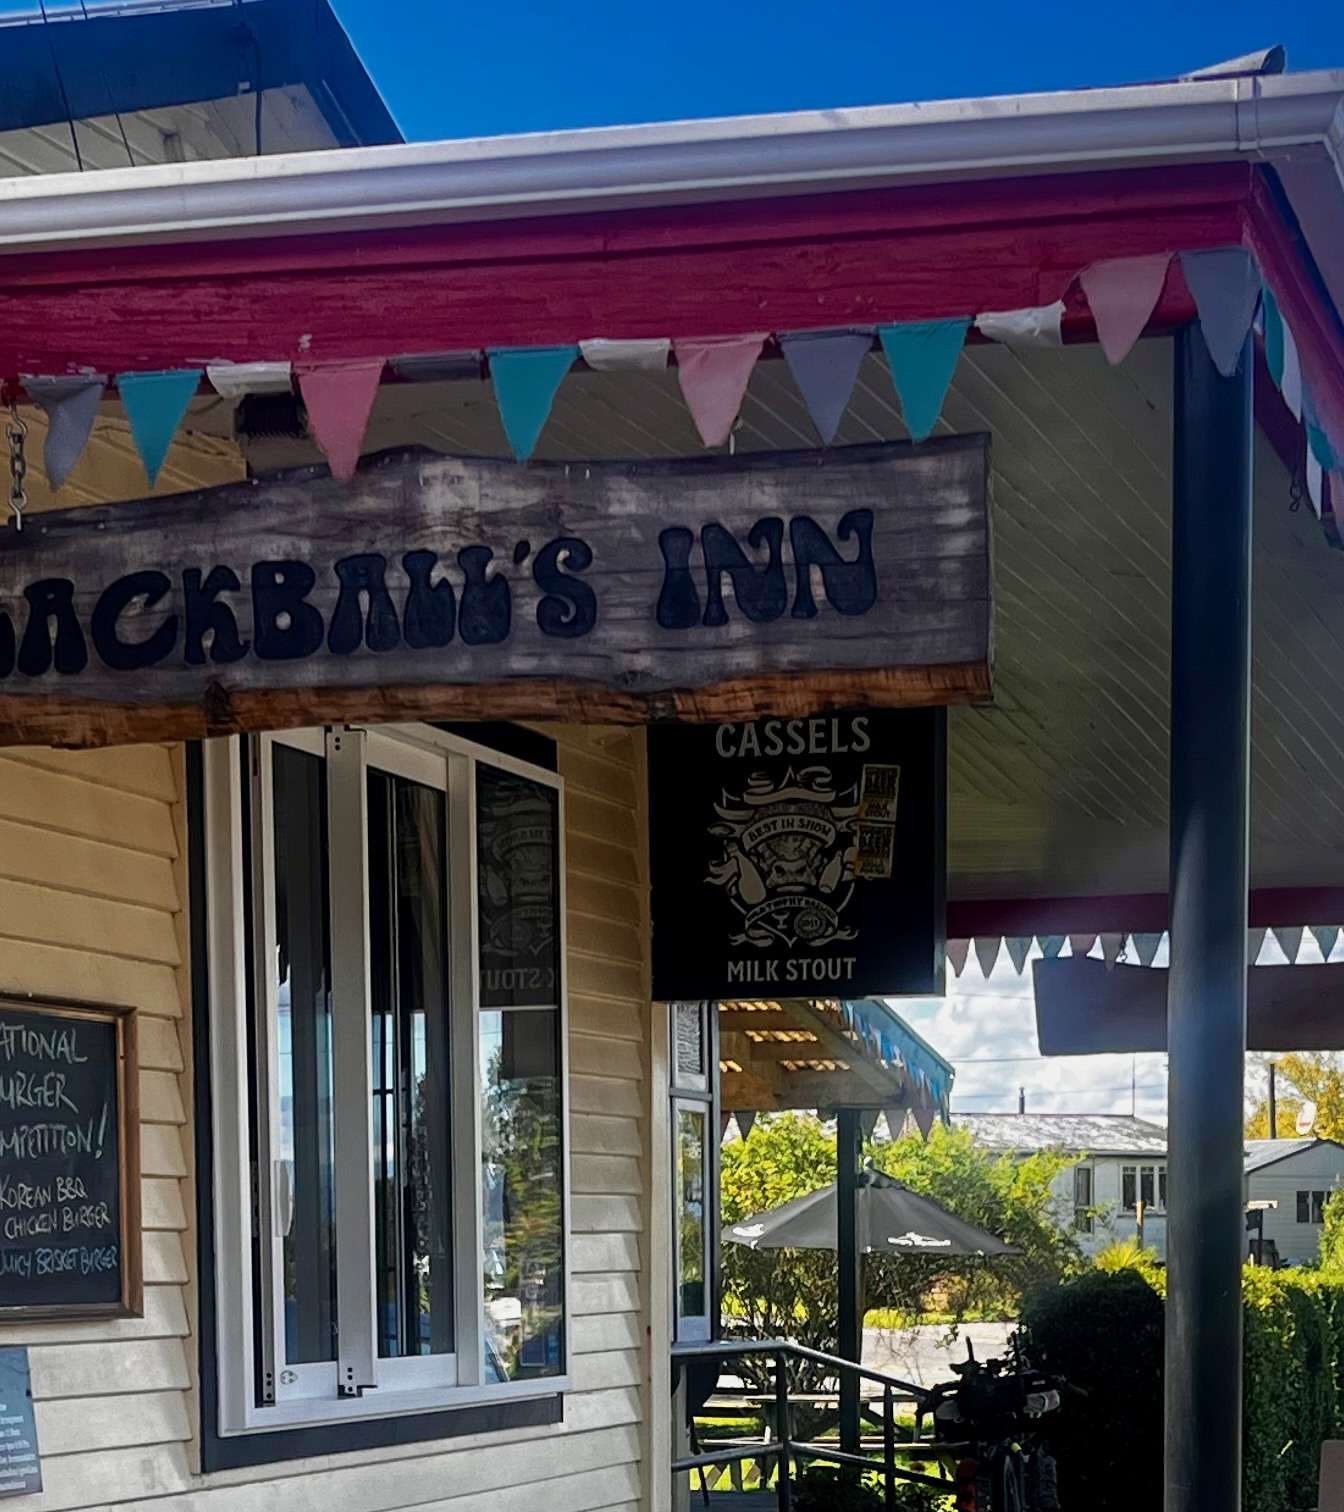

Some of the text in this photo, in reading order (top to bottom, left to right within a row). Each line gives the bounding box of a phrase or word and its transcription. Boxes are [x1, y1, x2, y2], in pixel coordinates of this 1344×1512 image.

[658, 510, 875, 629] INN
[716, 716, 871, 758] CASSELS
[748, 819, 831, 842] BEST IN SHOW
[727, 957, 858, 982] MILK STOUT
[56, 1176, 88, 1202] BBQ
[5, 1201, 112, 1239] CHICKEN BURGER
